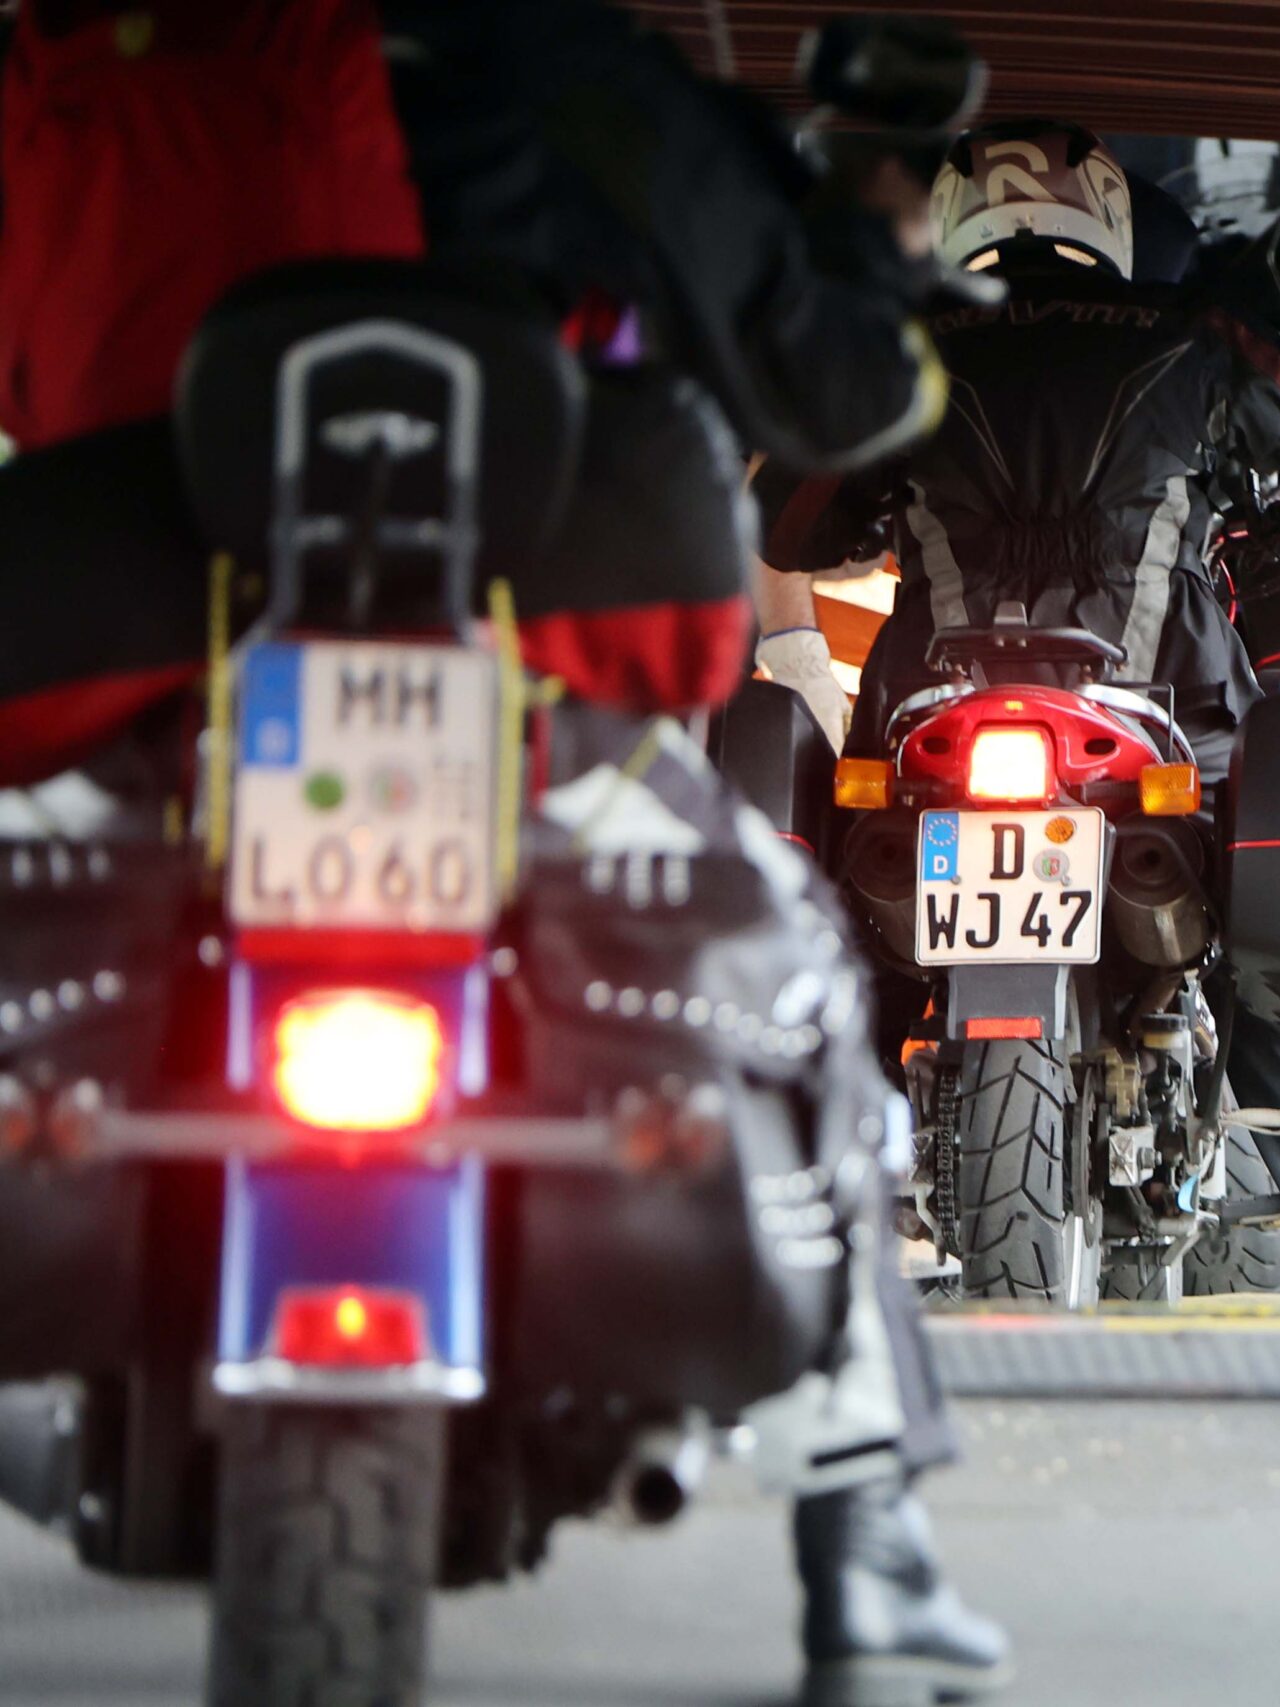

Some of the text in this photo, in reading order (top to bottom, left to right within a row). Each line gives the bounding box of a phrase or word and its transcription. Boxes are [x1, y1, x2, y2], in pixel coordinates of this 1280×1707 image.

[933, 855, 948, 874] D
[989, 823, 1025, 880] D
[926, 890, 1092, 950] WJ 47
